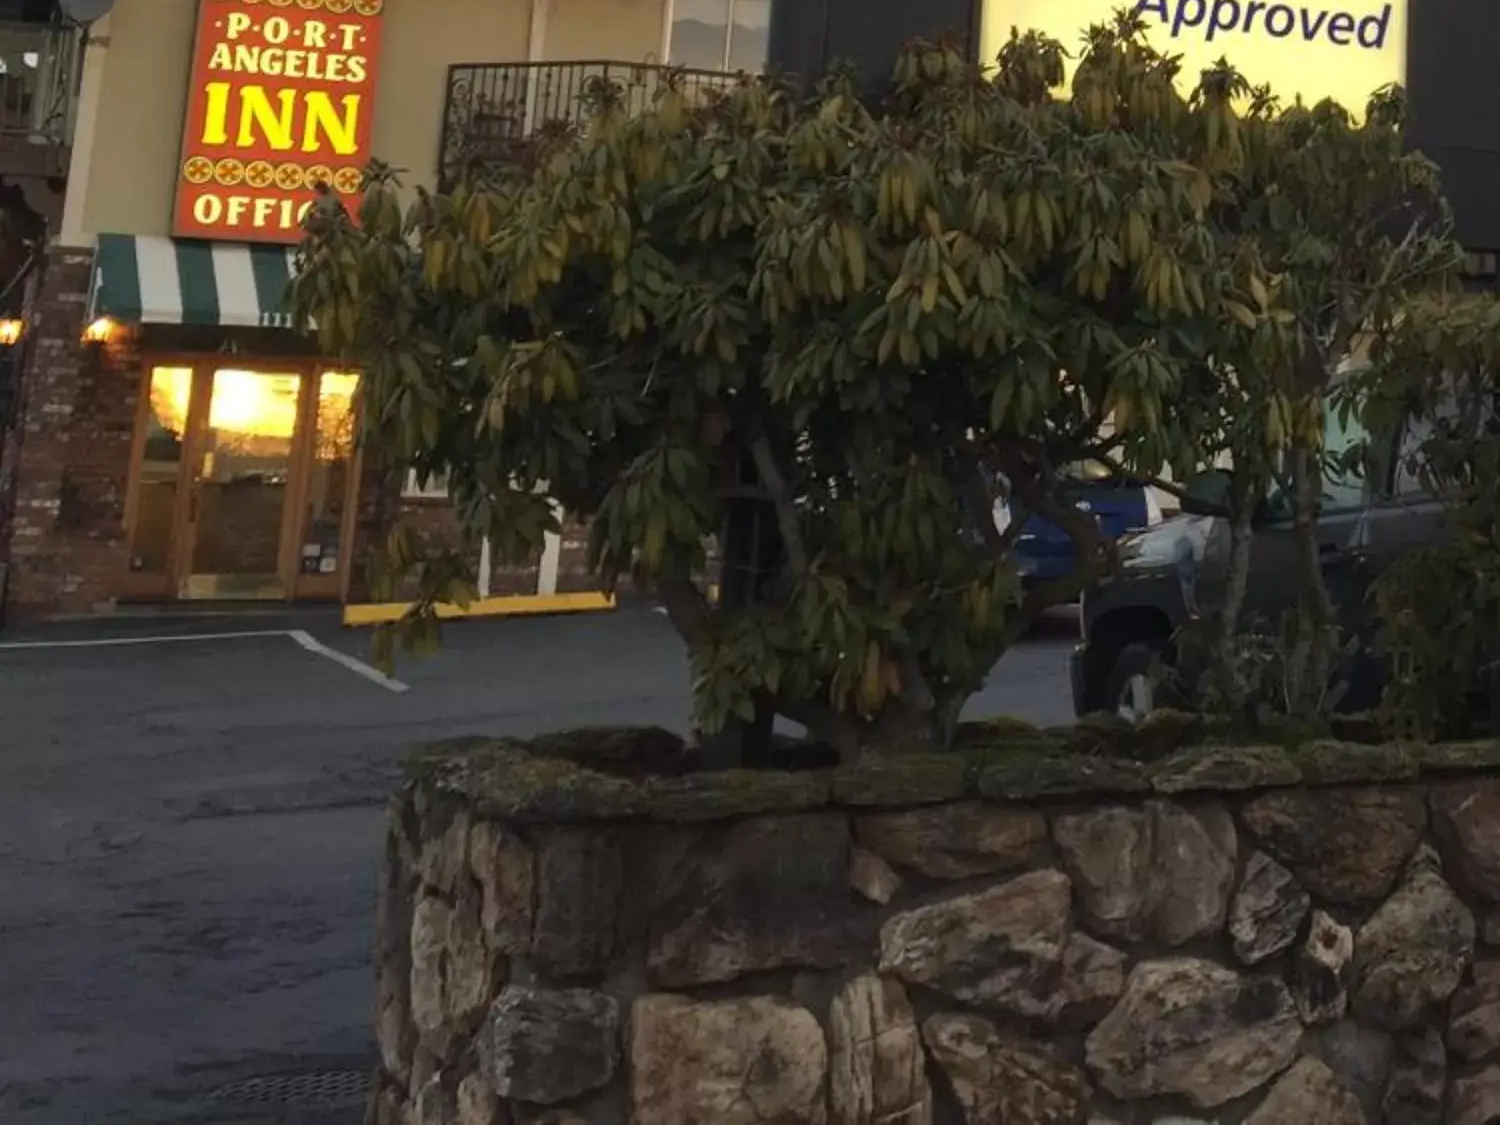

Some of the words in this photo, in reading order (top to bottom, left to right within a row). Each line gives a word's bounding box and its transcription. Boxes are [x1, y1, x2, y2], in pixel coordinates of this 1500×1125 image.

[208, 42, 367, 84] ANGELES
[201, 82, 362, 156] INN
[193, 193, 322, 229] OFFI
